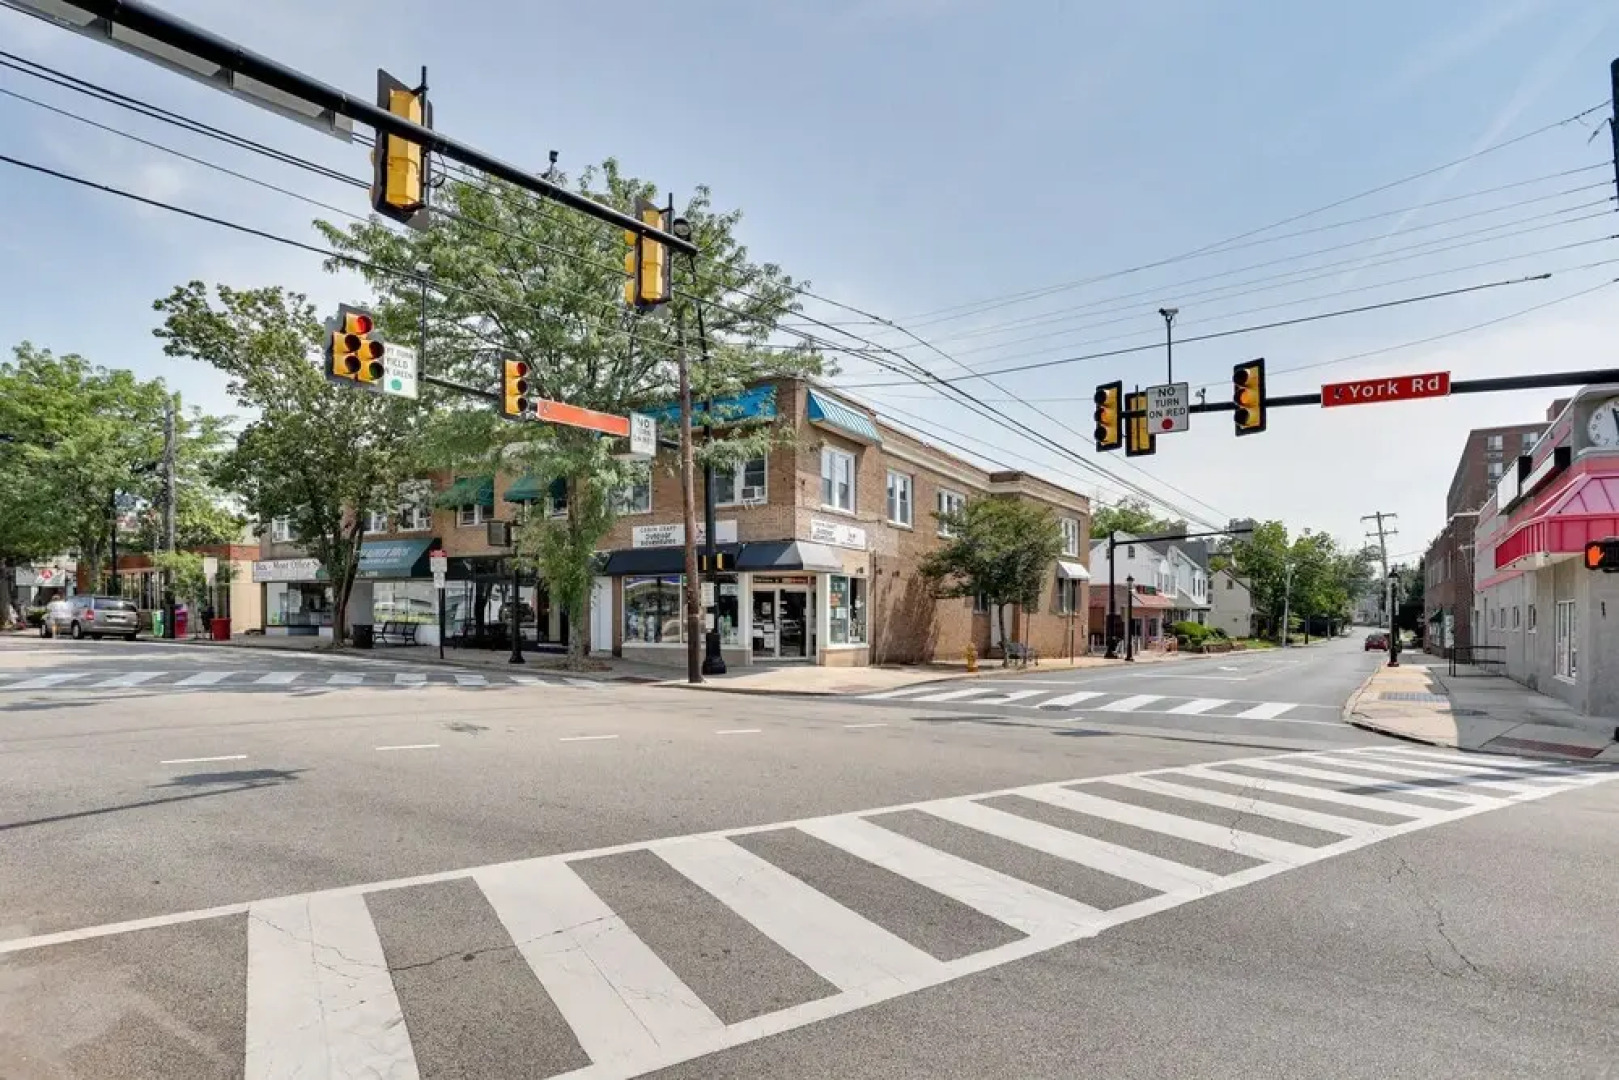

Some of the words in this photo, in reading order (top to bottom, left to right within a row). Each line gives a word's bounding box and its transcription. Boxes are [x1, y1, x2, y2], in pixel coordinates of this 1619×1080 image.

[1158, 386, 1175, 397] NO
[1349, 380, 1399, 398] York
[1411, 375, 1439, 393] Rd
[1155, 398, 1179, 408] TURN
[1149, 410, 1163, 419] ON
[1166, 407, 1186, 417] RED
[637, 417, 650, 428] NO
